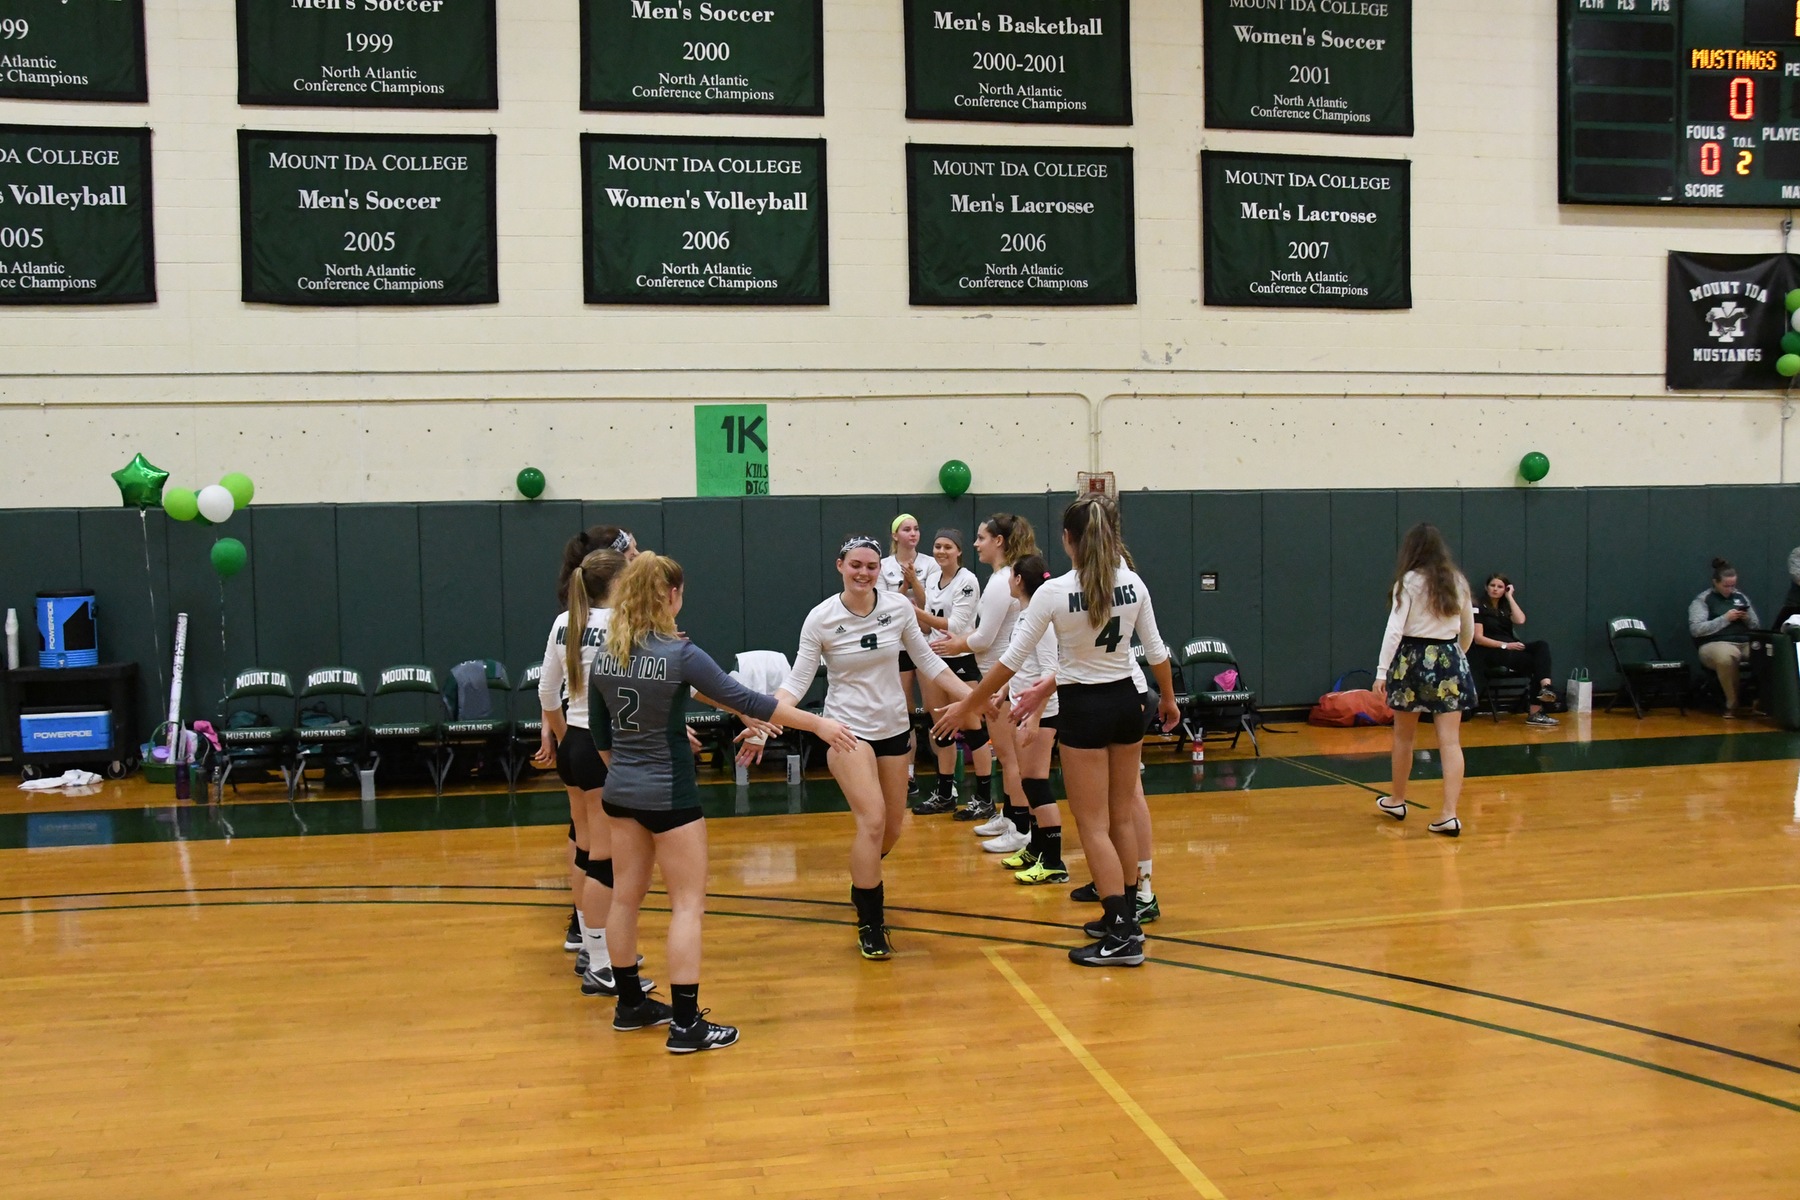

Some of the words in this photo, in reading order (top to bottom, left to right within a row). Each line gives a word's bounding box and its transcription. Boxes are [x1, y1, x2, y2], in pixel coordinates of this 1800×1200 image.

[291, 0, 356, 10] ens
[364, 0, 444, 13] Soccer
[630, 0, 692, 21] Men's
[699, 2, 775, 23] Soccer
[1290, 0, 1317, 13] IDA
[1320, 0, 1389, 17] COLLEGE
[1651, 0, 1671, 12] PTS
[0, 18, 29, 40] 99
[933, 10, 991, 32] Men's
[997, 14, 1103, 36] Basketball
[346, 32, 393, 54] 1999
[1233, 25, 1316, 47] Women's
[1321, 29, 1386, 51] Soccer
[682, 41, 730, 62] 2000
[1691, 48, 1778, 70] MUSTANGS
[0, 54, 57, 69] Atlantic
[972, 51, 1066, 73] 2000-2001
[6, 69, 89, 87] Champions
[321, 65, 361, 78] North
[364, 66, 417, 79] Atlantic
[657, 72, 697, 86] North
[699, 73, 749, 87] Atlantic
[1289, 64, 1330, 85] 2001
[293, 75, 368, 92] Conference
[372, 80, 445, 96] Champions
[632, 85, 702, 100] Conference
[704, 87, 775, 103] Champions
[978, 82, 1017, 97] North
[1018, 84, 1063, 97] Atlantic
[954, 93, 1020, 109] Conference
[1021, 94, 1087, 113] Champions
[1272, 94, 1304, 107] North
[1306, 96, 1348, 110] Atlantic
[1730, 77, 1754, 120] 0
[1250, 105, 1311, 120] Conference
[1312, 107, 1371, 124] Champions
[1686, 125, 1725, 140] FOULS
[1732, 136, 1756, 148] T.O.L.
[0, 147, 22, 164] DA
[26, 146, 120, 166] COLLEGE
[269, 152, 340, 170] MOUNT
[344, 154, 378, 171] IDA
[382, 154, 468, 171] COLLEGE
[607, 154, 679, 172] MOUNT
[682, 157, 715, 173] IDA
[718, 157, 802, 174] COLLEGE
[1700, 142, 1720, 176] 0
[1736, 150, 1753, 175] 2
[933, 160, 996, 176] MOUNT
[1000, 161, 1030, 177] IDA
[1033, 161, 1108, 178] COLLEGE
[1224, 169, 1286, 187] MOUNT
[1288, 172, 1317, 188] IDA
[1319, 173, 1391, 190] COLLEGE
[7, 184, 128, 211] Volleyball
[298, 188, 360, 210] Men's
[365, 190, 442, 211] Soccer
[1684, 184, 1723, 198] SCORE
[604, 187, 701, 210] Women's
[703, 190, 808, 216] Volleyball
[950, 193, 1005, 214] Men's
[1010, 194, 1095, 214] Lacrosse
[1240, 201, 1292, 221] Men's
[1297, 204, 1377, 224] Lacrosse
[0, 227, 44, 249] 005
[343, 231, 396, 252] 2005
[682, 230, 730, 250] 2006
[1000, 232, 1047, 252] 2006
[1288, 241, 1330, 260] 2007
[10, 261, 65, 275] Atlantic
[324, 263, 363, 277] North
[365, 263, 416, 277] Atlantic
[661, 262, 700, 275] North
[702, 262, 755, 279] Atlantic
[985, 263, 1018, 278] North
[1020, 263, 1064, 278] Atlantic
[1270, 270, 1302, 284] North
[1304, 270, 1349, 285] Atlantic
[19, 275, 97, 292] Champions
[297, 272, 370, 291] Conference
[373, 274, 444, 294] Champions
[635, 274, 705, 288] Conference
[707, 275, 778, 292] Champions
[958, 275, 1024, 289] Conference
[1027, 275, 1089, 292] Champions
[1249, 280, 1308, 295] Conference
[1309, 282, 1369, 298] Champions
[1689, 281, 1740, 302] MOUNT
[1744, 283, 1768, 303] IDA
[1693, 348, 1762, 362] MUSTANGS
[721, 415, 767, 454] 1K
[746, 480, 768, 494] DIGS
[1068, 584, 1137, 613] MUNGS
[47, 601, 55, 650] POWERADE
[1095, 615, 1124, 653] 4
[556, 626, 607, 647] MNGS
[1184, 640, 1212, 658] MOUNT
[1213, 641, 1228, 655] IDA
[382, 668, 415, 686] MOUNT
[416, 669, 432, 683] IDA
[637, 656, 667, 681] IDA
[236, 671, 270, 690] MOUNT
[271, 673, 287, 687] IDA
[308, 669, 342, 688] MOUNT
[342, 671, 358, 686] IDA
[1211, 693, 1250, 702] MUSTANGS
[617, 686, 640, 732] 2
[448, 723, 493, 733] MUSTANGS
[685, 715, 721, 724] USTANGS
[33, 729, 93, 740] POWERADE
[225, 731, 272, 741] MUSTANGS
[300, 729, 347, 738] MUSTANGS
[375, 727, 420, 736] MUSTANGS
